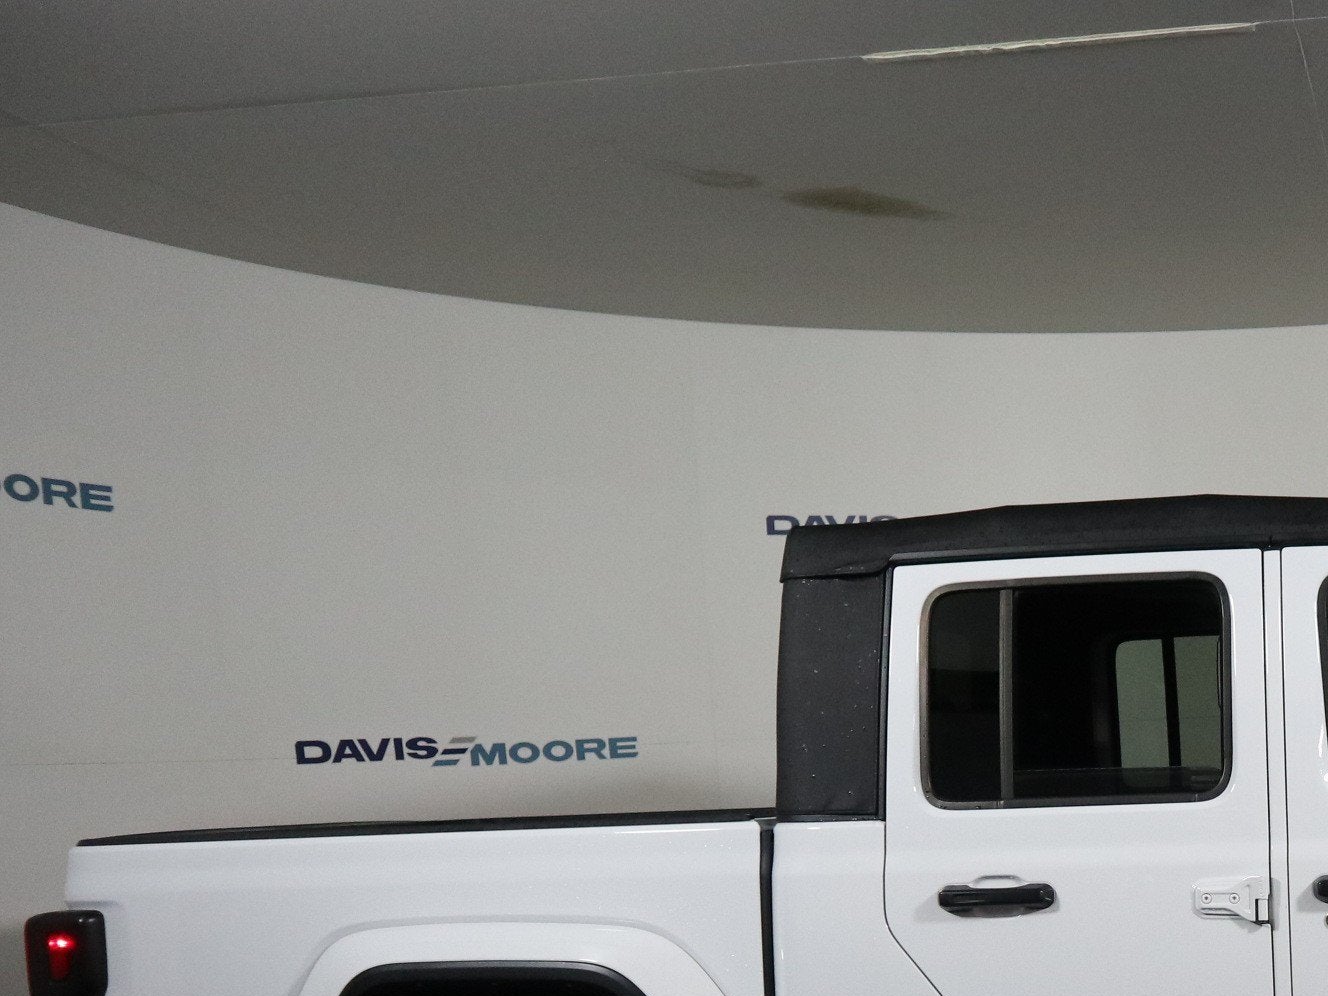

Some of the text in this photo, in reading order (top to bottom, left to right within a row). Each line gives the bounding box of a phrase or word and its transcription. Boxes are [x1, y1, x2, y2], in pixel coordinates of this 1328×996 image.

[0, 473, 114, 512] ORE
[295, 736, 638, 766] DAVIS MOORE
